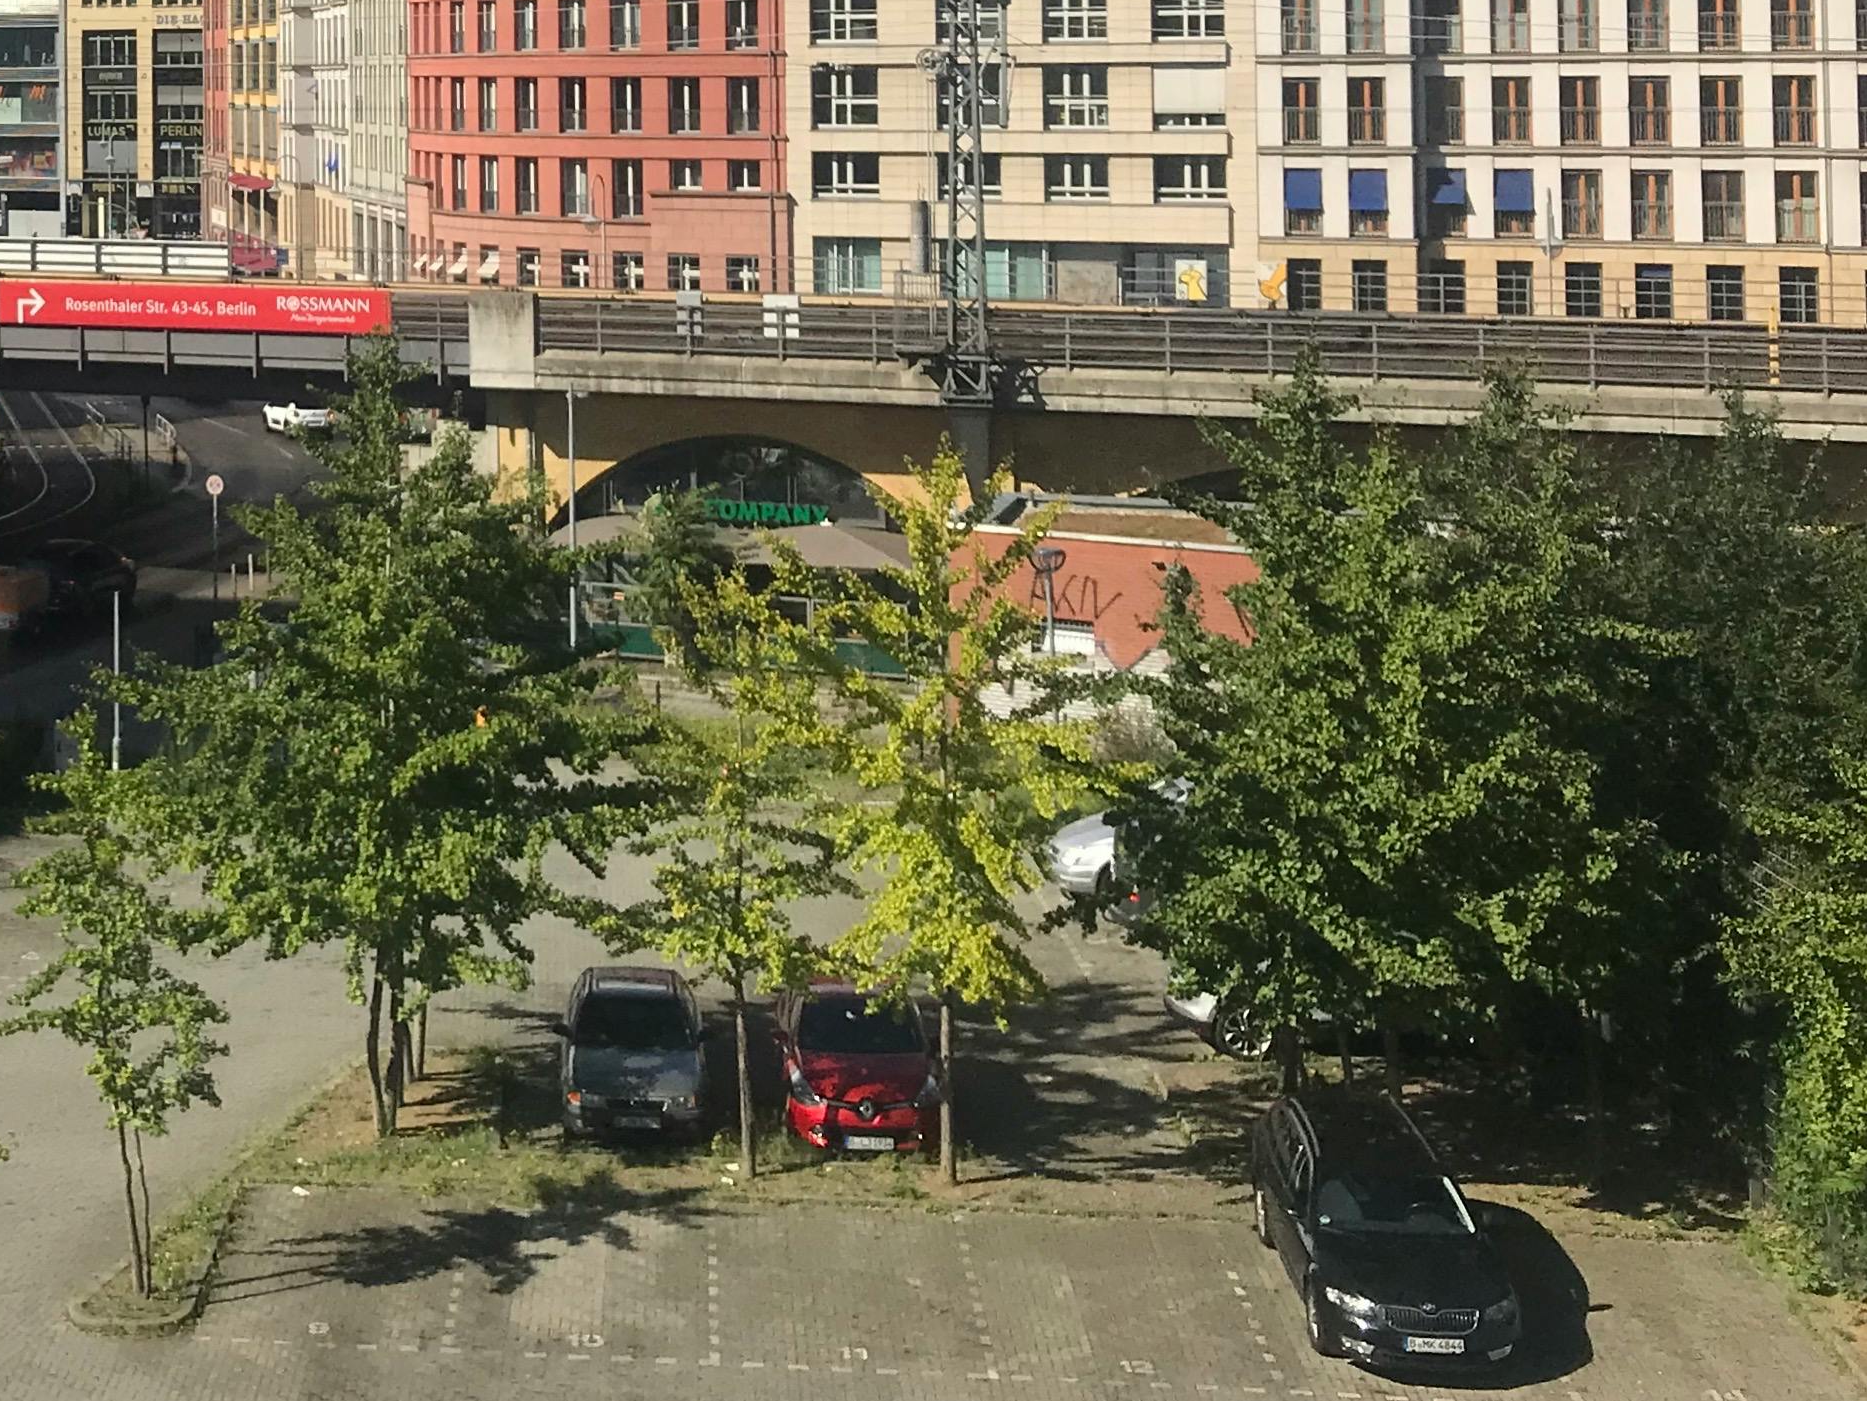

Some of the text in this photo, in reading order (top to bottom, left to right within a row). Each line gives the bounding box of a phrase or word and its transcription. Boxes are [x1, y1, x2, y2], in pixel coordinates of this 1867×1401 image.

[65, 297, 256, 317] Rosenthaler Str. 43-45, Berlin
[276, 295, 371, 313] ROSSMANN
